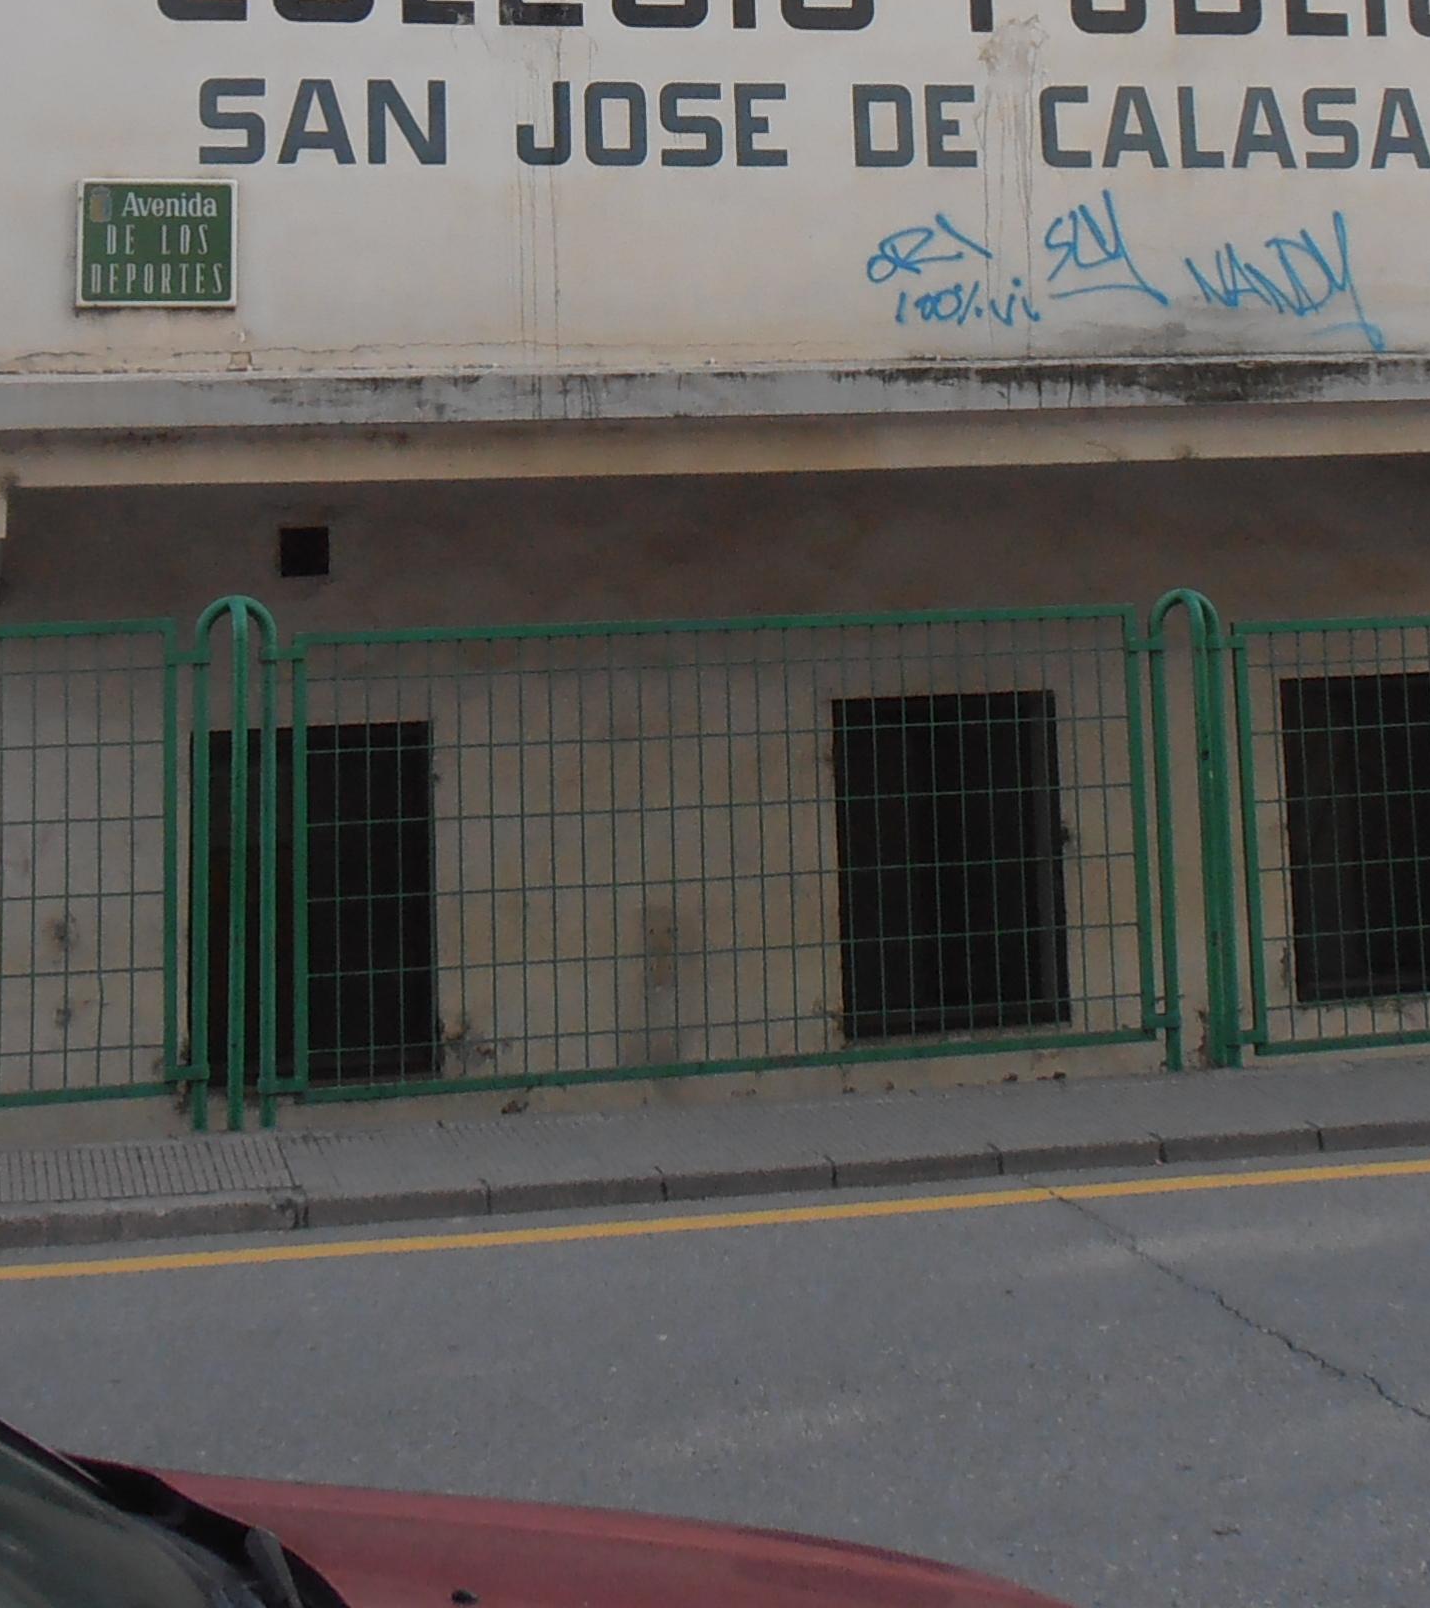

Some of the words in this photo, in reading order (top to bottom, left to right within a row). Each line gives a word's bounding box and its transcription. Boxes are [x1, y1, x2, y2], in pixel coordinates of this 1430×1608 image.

[197, 76, 448, 167] SAN
[514, 79, 790, 169] JOSE
[851, 82, 979, 169] DE
[122, 191, 218, 218] Avenida
[106, 223, 136, 256] DE
[160, 223, 209, 256] LOS
[90, 262, 224, 295] DEPORTES
